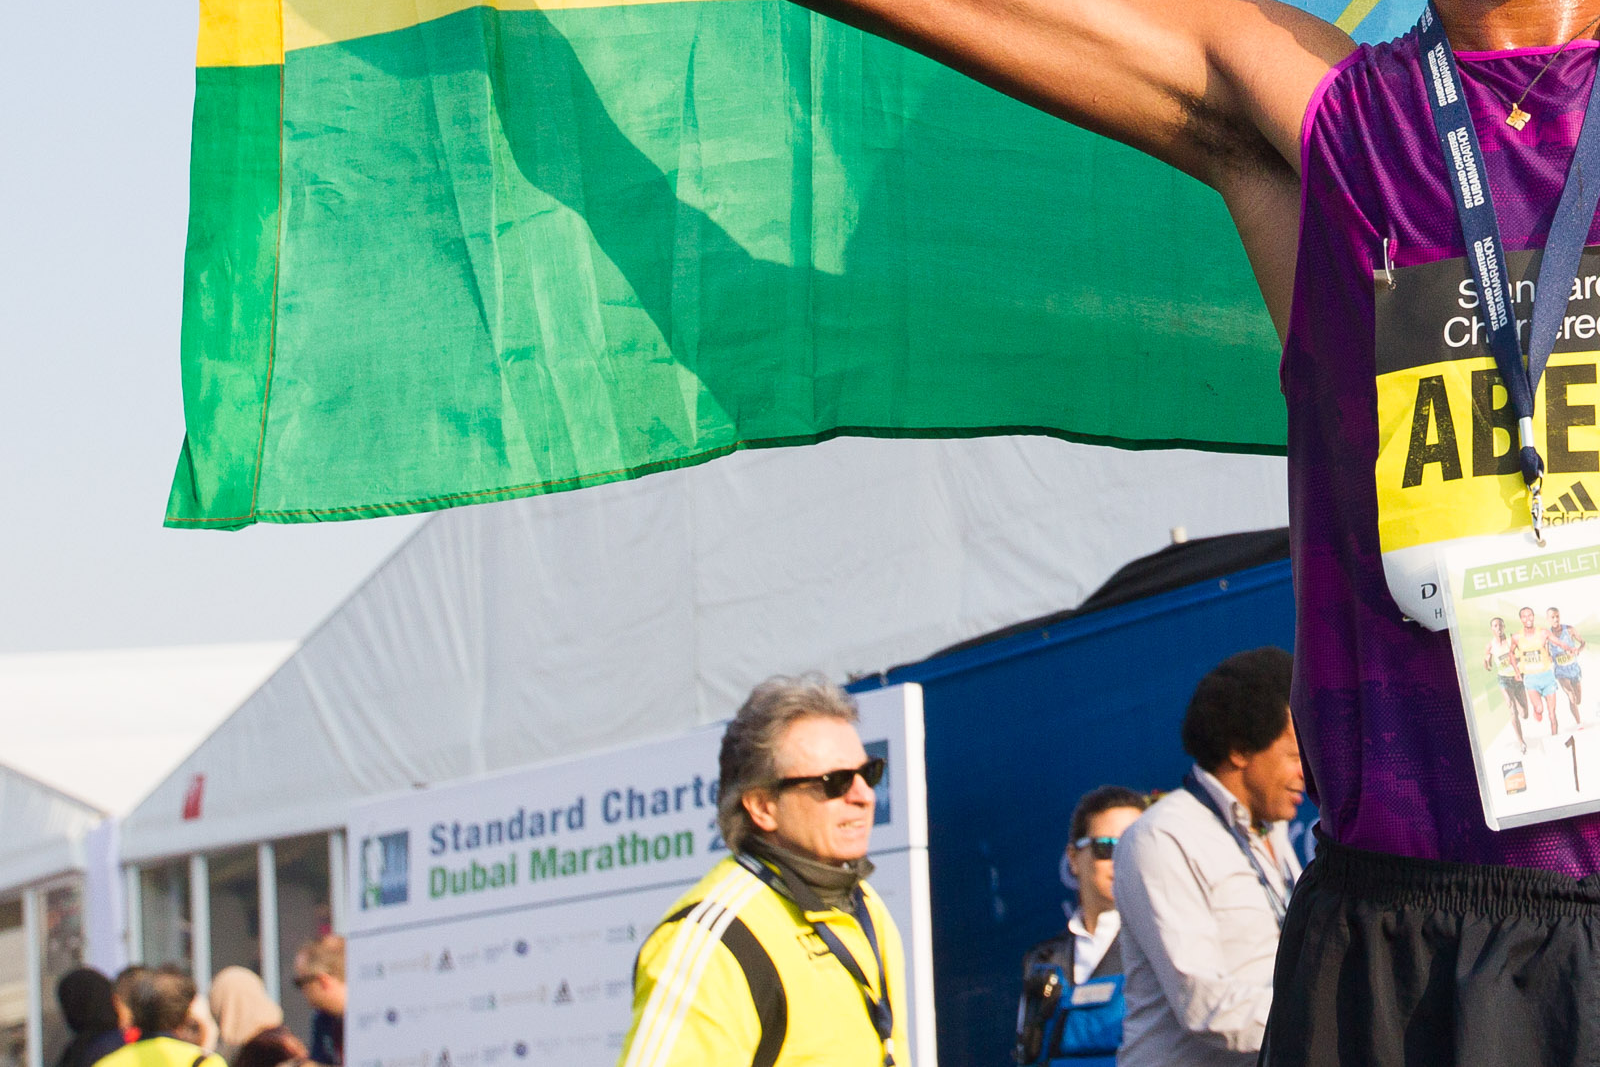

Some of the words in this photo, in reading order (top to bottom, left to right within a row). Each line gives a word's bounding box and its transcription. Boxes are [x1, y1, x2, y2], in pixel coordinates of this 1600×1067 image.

[1564, 735, 1580, 792] 1
[429, 795, 586, 857] Standard
[429, 851, 518, 901] Dubai
[528, 829, 696, 882] Marathon
